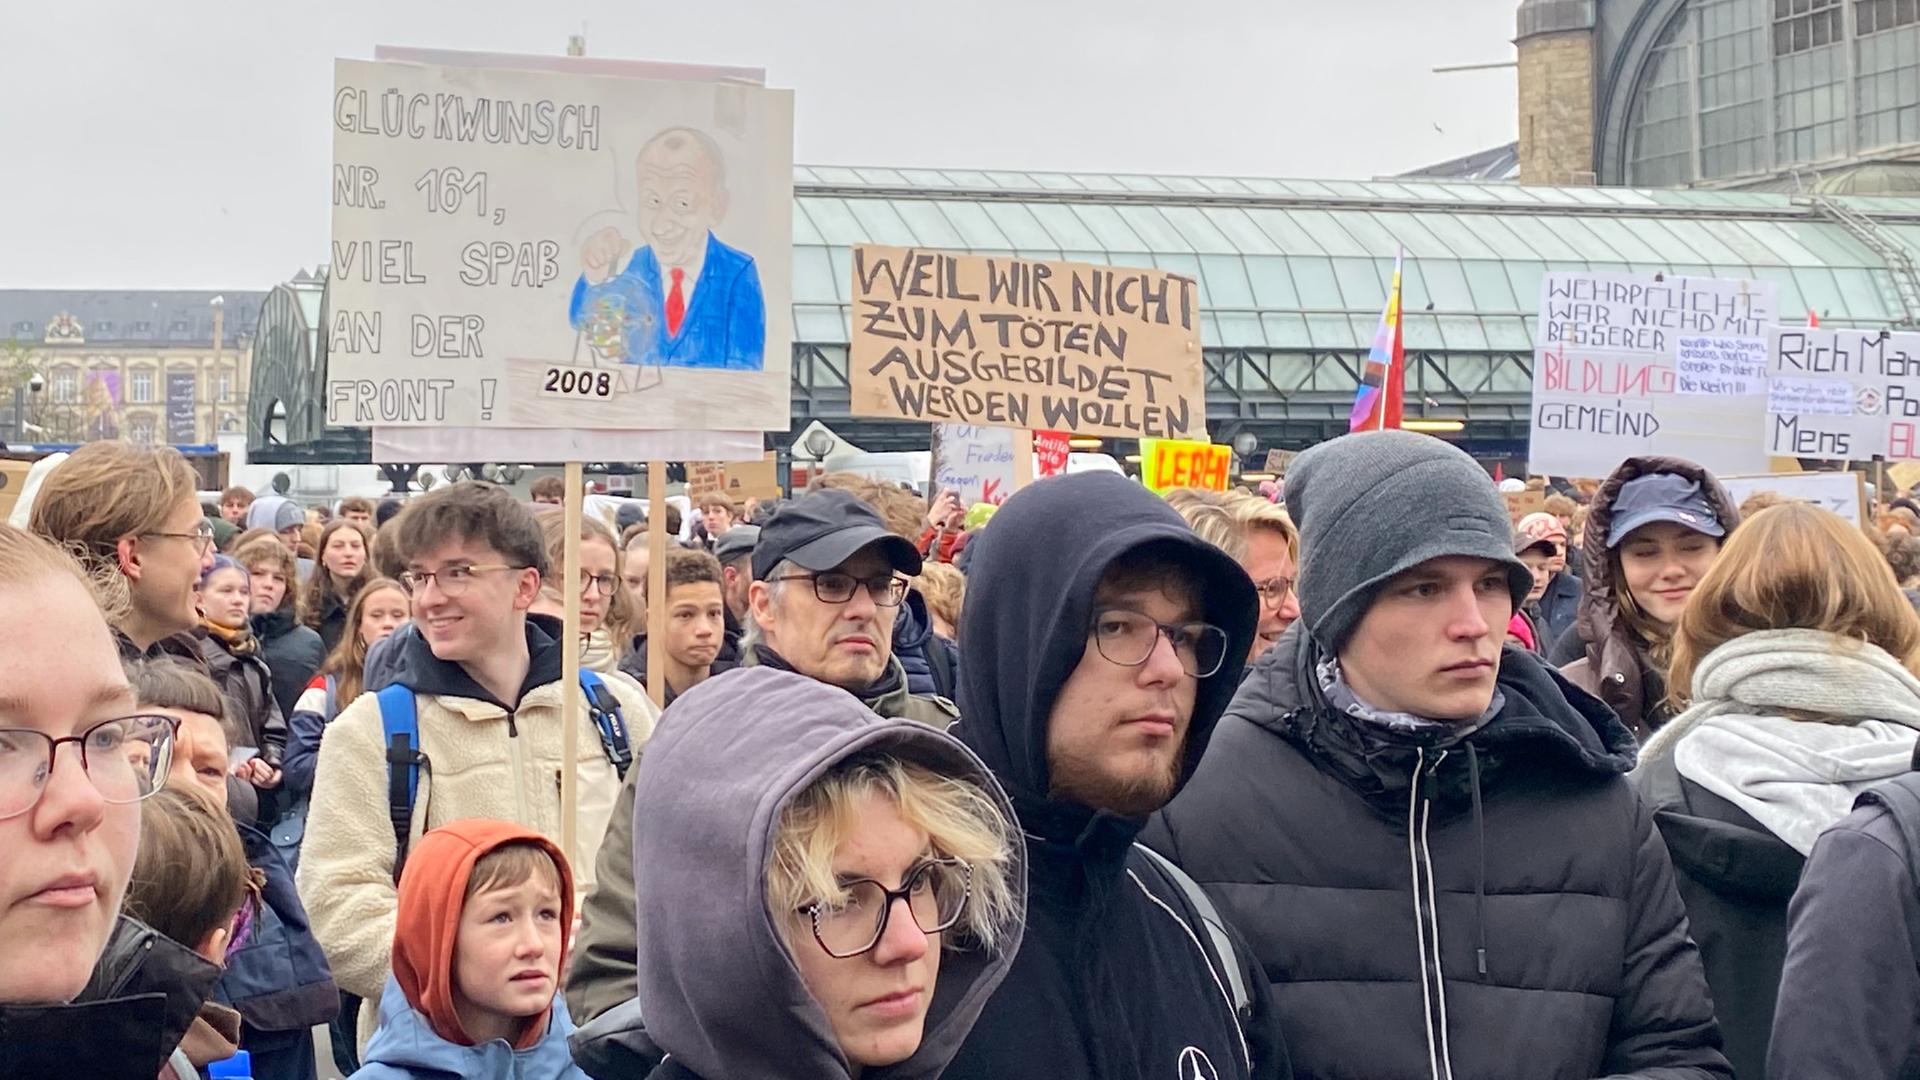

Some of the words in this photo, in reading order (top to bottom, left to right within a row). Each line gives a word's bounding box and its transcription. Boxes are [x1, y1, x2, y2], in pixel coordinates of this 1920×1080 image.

[335, 86, 600, 151] GLÜCKWUNSCH
[333, 164, 385, 209] NR.
[415, 167, 505, 226] 161,
[332, 240, 427, 284] VIEL
[855, 248, 979, 301] WEIL
[987, 259, 1061, 312] WIR
[1072, 269, 1197, 330] NICHT
[329, 309, 381, 354] AN
[411, 314, 485, 358] DER
[859, 300, 977, 349] ZUM
[980, 313, 1127, 360] TÖTEN
[1548, 320, 1664, 352] BESSERER
[1549, 301, 1609, 325] WAR
[1724, 316, 1768, 336] MIT
[869, 347, 1171, 403] AUSGEBILDET
[1778, 333, 1849, 372] Rich
[329, 379, 455, 422] FRONT
[545, 369, 612, 396] 2008
[889, 376, 1028, 426] WERDEN
[1041, 395, 1190, 439] WOLLEN
[1773, 414, 1851, 454] Mens
